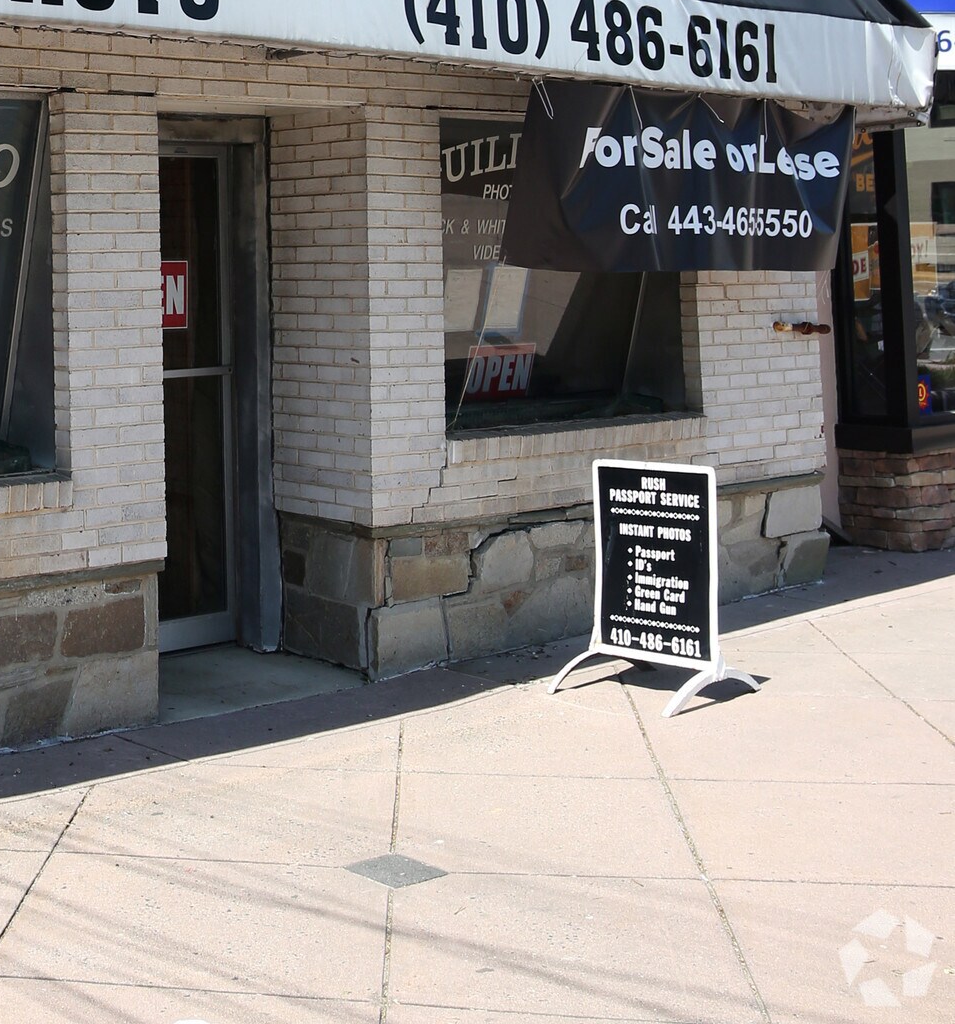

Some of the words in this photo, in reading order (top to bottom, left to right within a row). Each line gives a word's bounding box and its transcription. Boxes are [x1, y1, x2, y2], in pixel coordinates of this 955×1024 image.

[579, 127, 639, 169] For
[641, 126, 717, 170] Sale
[725, 142, 758, 173] or
[460, 218, 470, 235] &
[465, 353, 532, 394] OPEN
[641, 476, 666, 491] RUSH
[609, 488, 657, 505] PASSPORT
[660, 492, 700, 508] SERVICE
[619, 522, 655, 538] INSTANT
[657, 526, 692, 542] PHOTOS
[634, 544, 676, 561] Passport
[634, 558, 652, 572] ID's
[634, 571, 689, 590] Immigration
[634, 585, 661, 600] Green
[663, 588, 686, 603] Card
[634, 598, 656, 613] Hand
[659, 602, 677, 616] Gun
[610, 627, 702, 658] 410-486-6161
